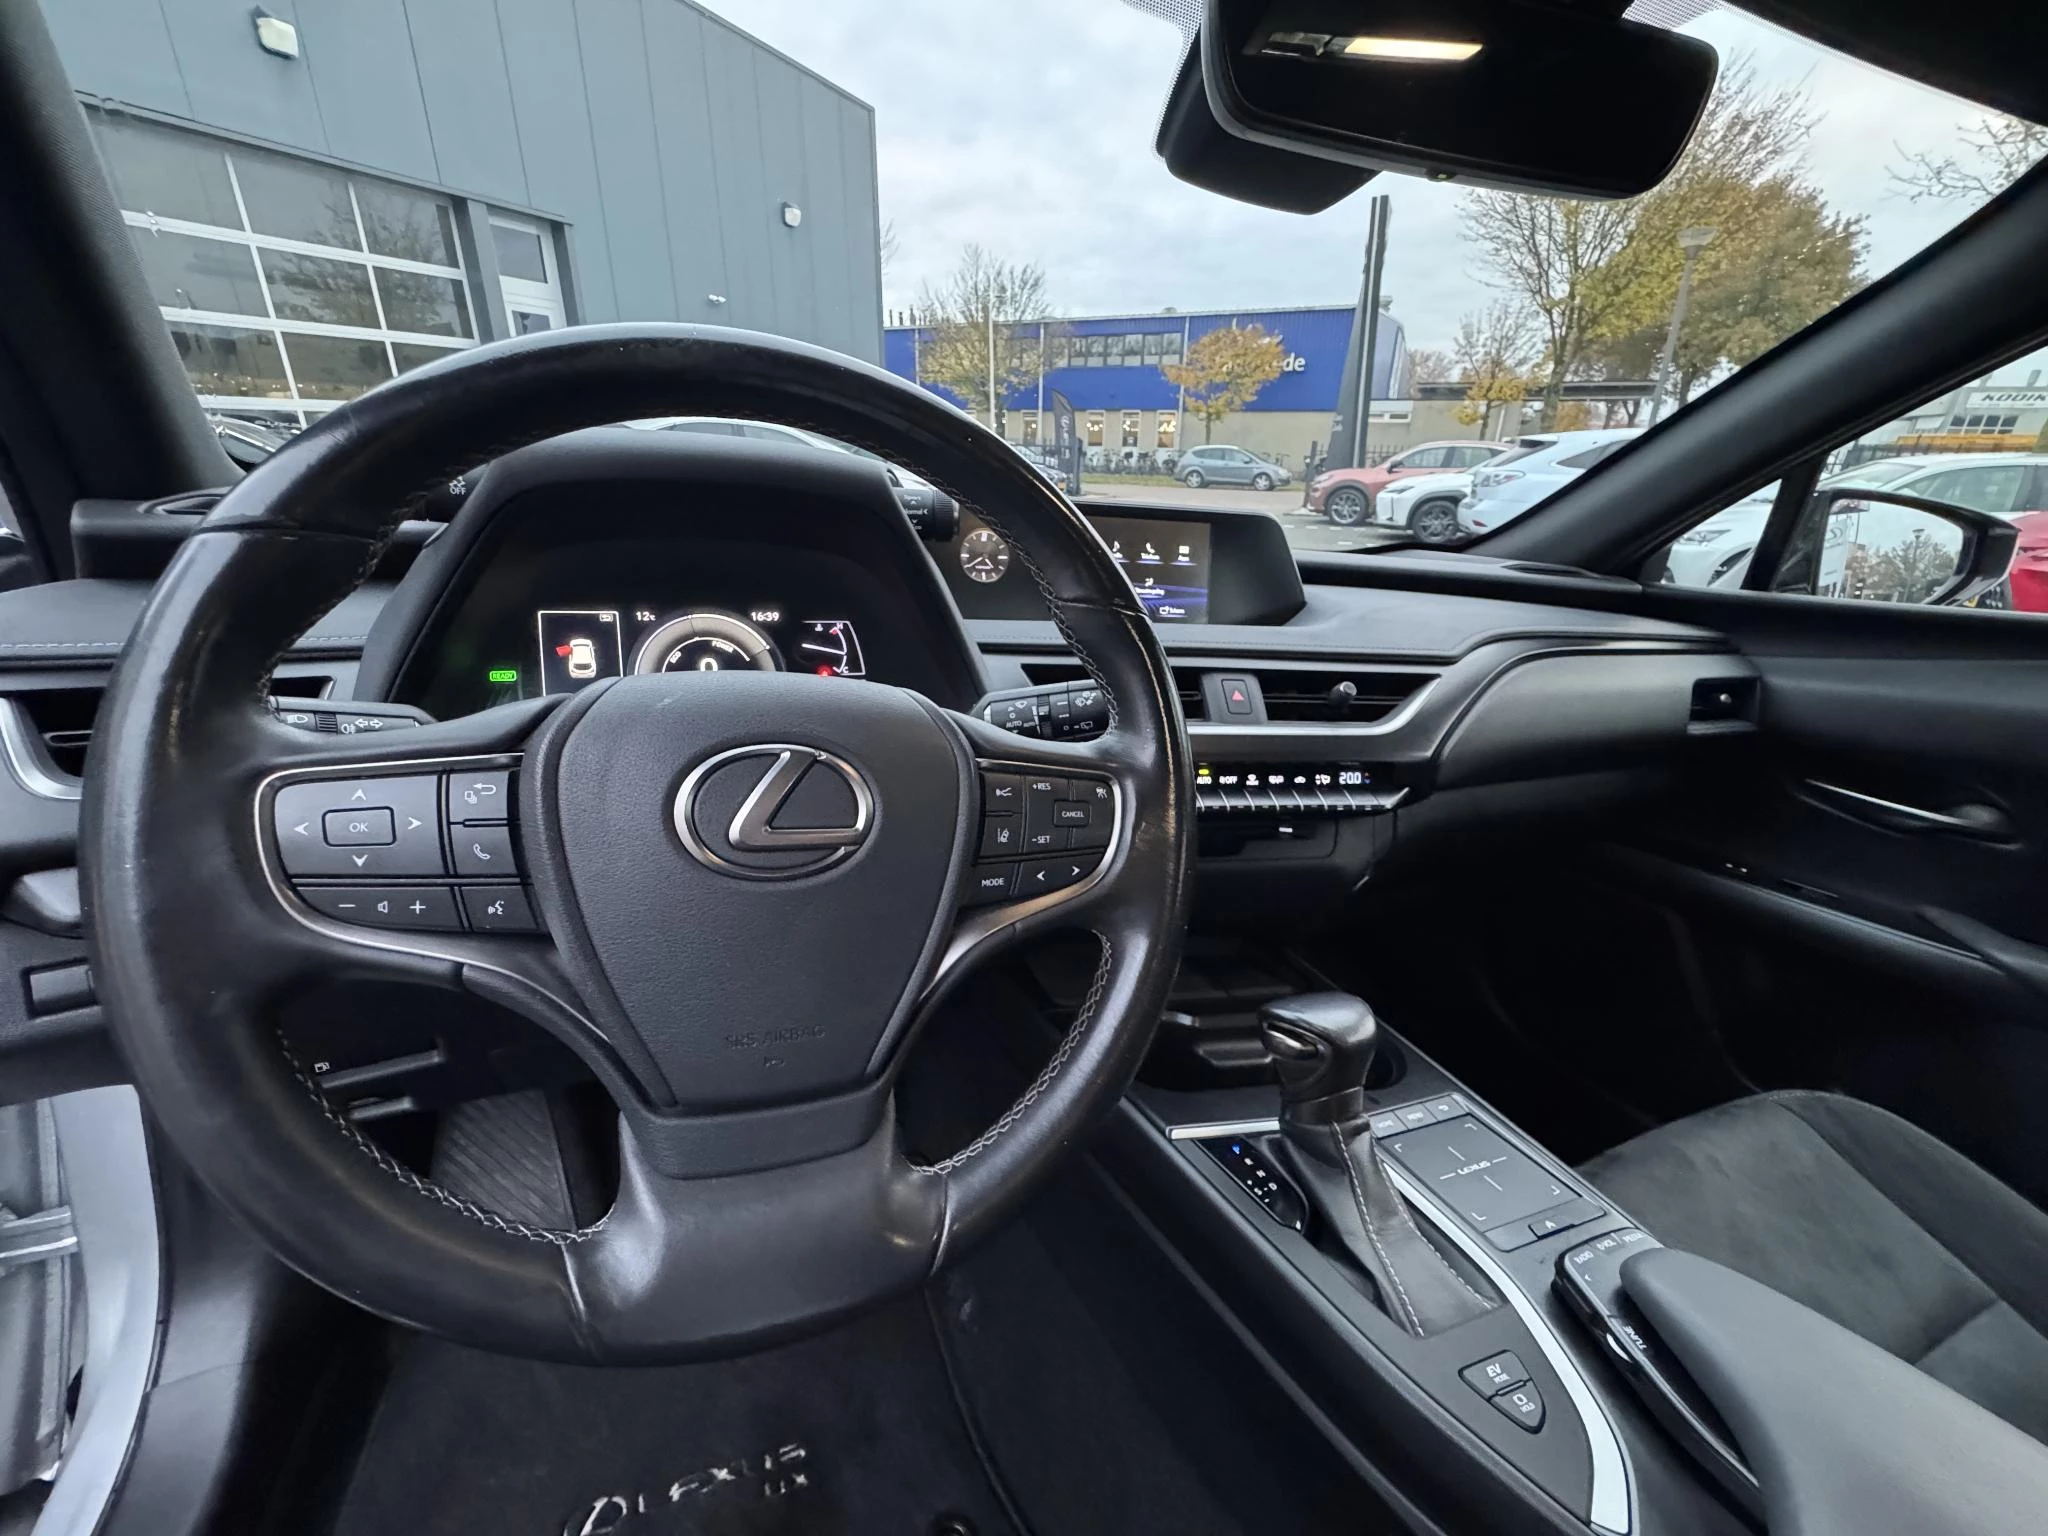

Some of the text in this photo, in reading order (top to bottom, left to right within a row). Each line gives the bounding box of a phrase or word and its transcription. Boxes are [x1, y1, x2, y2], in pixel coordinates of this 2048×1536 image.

[449, 487, 466, 495] OFF
[751, 611, 780, 622] 16:39
[711, 640, 735, 653] POWER
[669, 651, 682, 664] ECO
[492, 672, 515, 680] READY
[1006, 720, 1022, 729] AUTO
[1197, 775, 1212, 785] AUTO
[1061, 810, 1085, 818] CANCEL
[349, 822, 369, 833] OK
[981, 877, 1005, 887] MODE
[762, 1025, 826, 1044] AIRBAG
[1623, 1325, 1648, 1350] TUNE
[1485, 1362, 1502, 1378] EV
